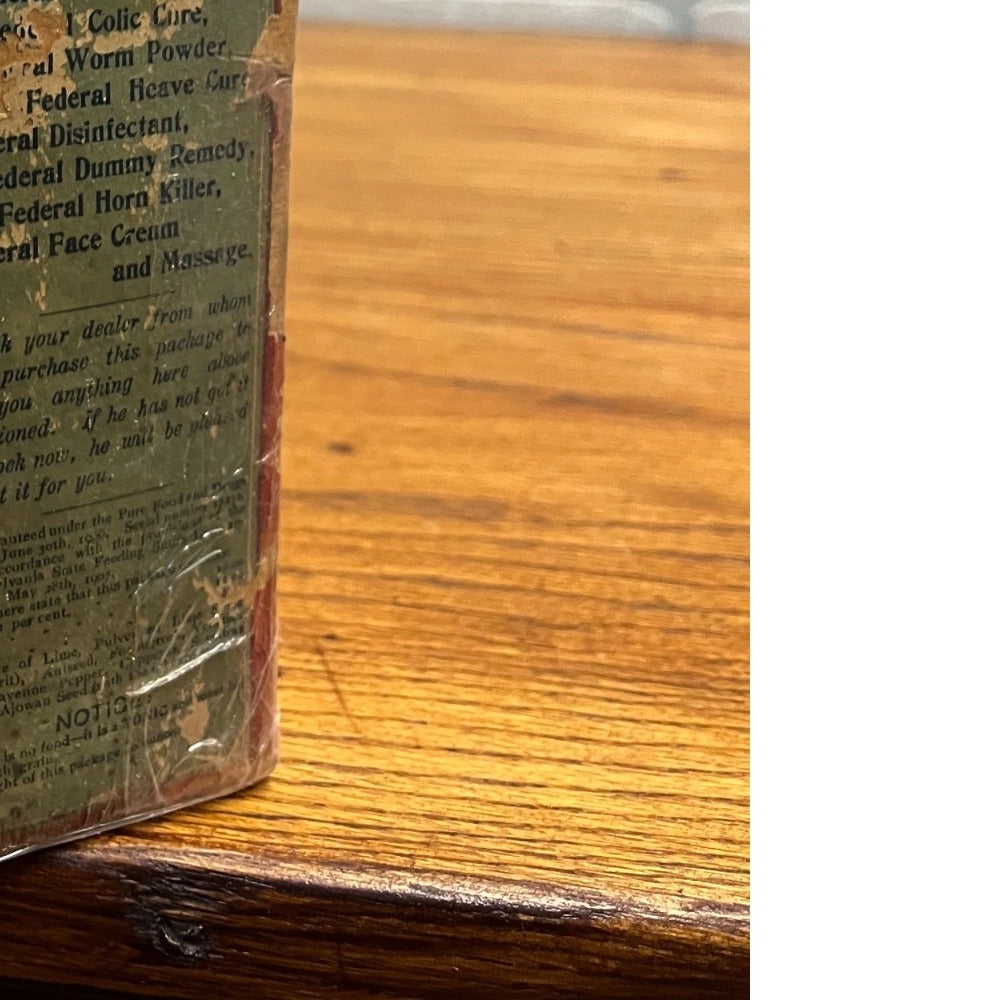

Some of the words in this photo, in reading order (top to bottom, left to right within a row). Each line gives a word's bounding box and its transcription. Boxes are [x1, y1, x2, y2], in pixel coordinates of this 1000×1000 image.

[88, 8, 142, 34] Colic
[152, 3, 208, 27] Cure,
[65, 47, 135, 74] Worm
[26, 82, 112, 114] Federal
[129, 76, 194, 102] Heave
[50, 110, 189, 148] Disinfectant,
[75, 154, 155, 182] Dummy
[95, 189, 149, 215] Horn
[160, 178, 222, 205] Killer,
[49, 230, 102, 257] Face
[111, 218, 180, 247] Cream
[112, 256, 151, 283] and
[24, 330, 70, 355] your
[82, 315, 140, 340] dealer
[149, 306, 193, 331] from
[208, 293, 251, 316] whom
[0, 355, 89, 389] purchase
[106, 342, 140, 366] this
[154, 328, 225, 361] package
[52, 376, 133, 407] anything
[152, 365, 190, 385] here
[207, 350, 250, 373] above
[107, 404, 128, 424] he
[137, 397, 168, 418] has
[175, 387, 201, 409] not
[33, 447, 76, 470] now,
[88, 438, 110, 457] he
[122, 424, 154, 449] will
[165, 420, 183, 440] be
[15, 481, 30, 501] it
[34, 476, 67, 501] for
[75, 470, 113, 495] you.
[48, 519, 87, 536] under
[92, 514, 112, 527] the
[118, 505, 146, 520] Pure
[1, 546, 34, 564] June
[76, 543, 104, 560] with
[112, 535, 133, 550] the
[52, 563, 87, 579] State
[95, 549, 145, 568] Feeding
[6, 587, 37, 605] May
[30, 596, 62, 612] state
[66, 588, 92, 602] that
[96, 580, 121, 596] this
[12, 616, 34, 632] per
[37, 606, 71, 624] cent.
[18, 653, 33, 669] of
[43, 646, 82, 665] Lime,
[0, 696, 51, 718] Ajowan
[4, 751, 16, 763] is
[20, 746, 37, 759] no
[98, 723, 109, 736] is
[110, 723, 119, 733] a
[22, 769, 37, 784] of
[40, 763, 66, 780] this
